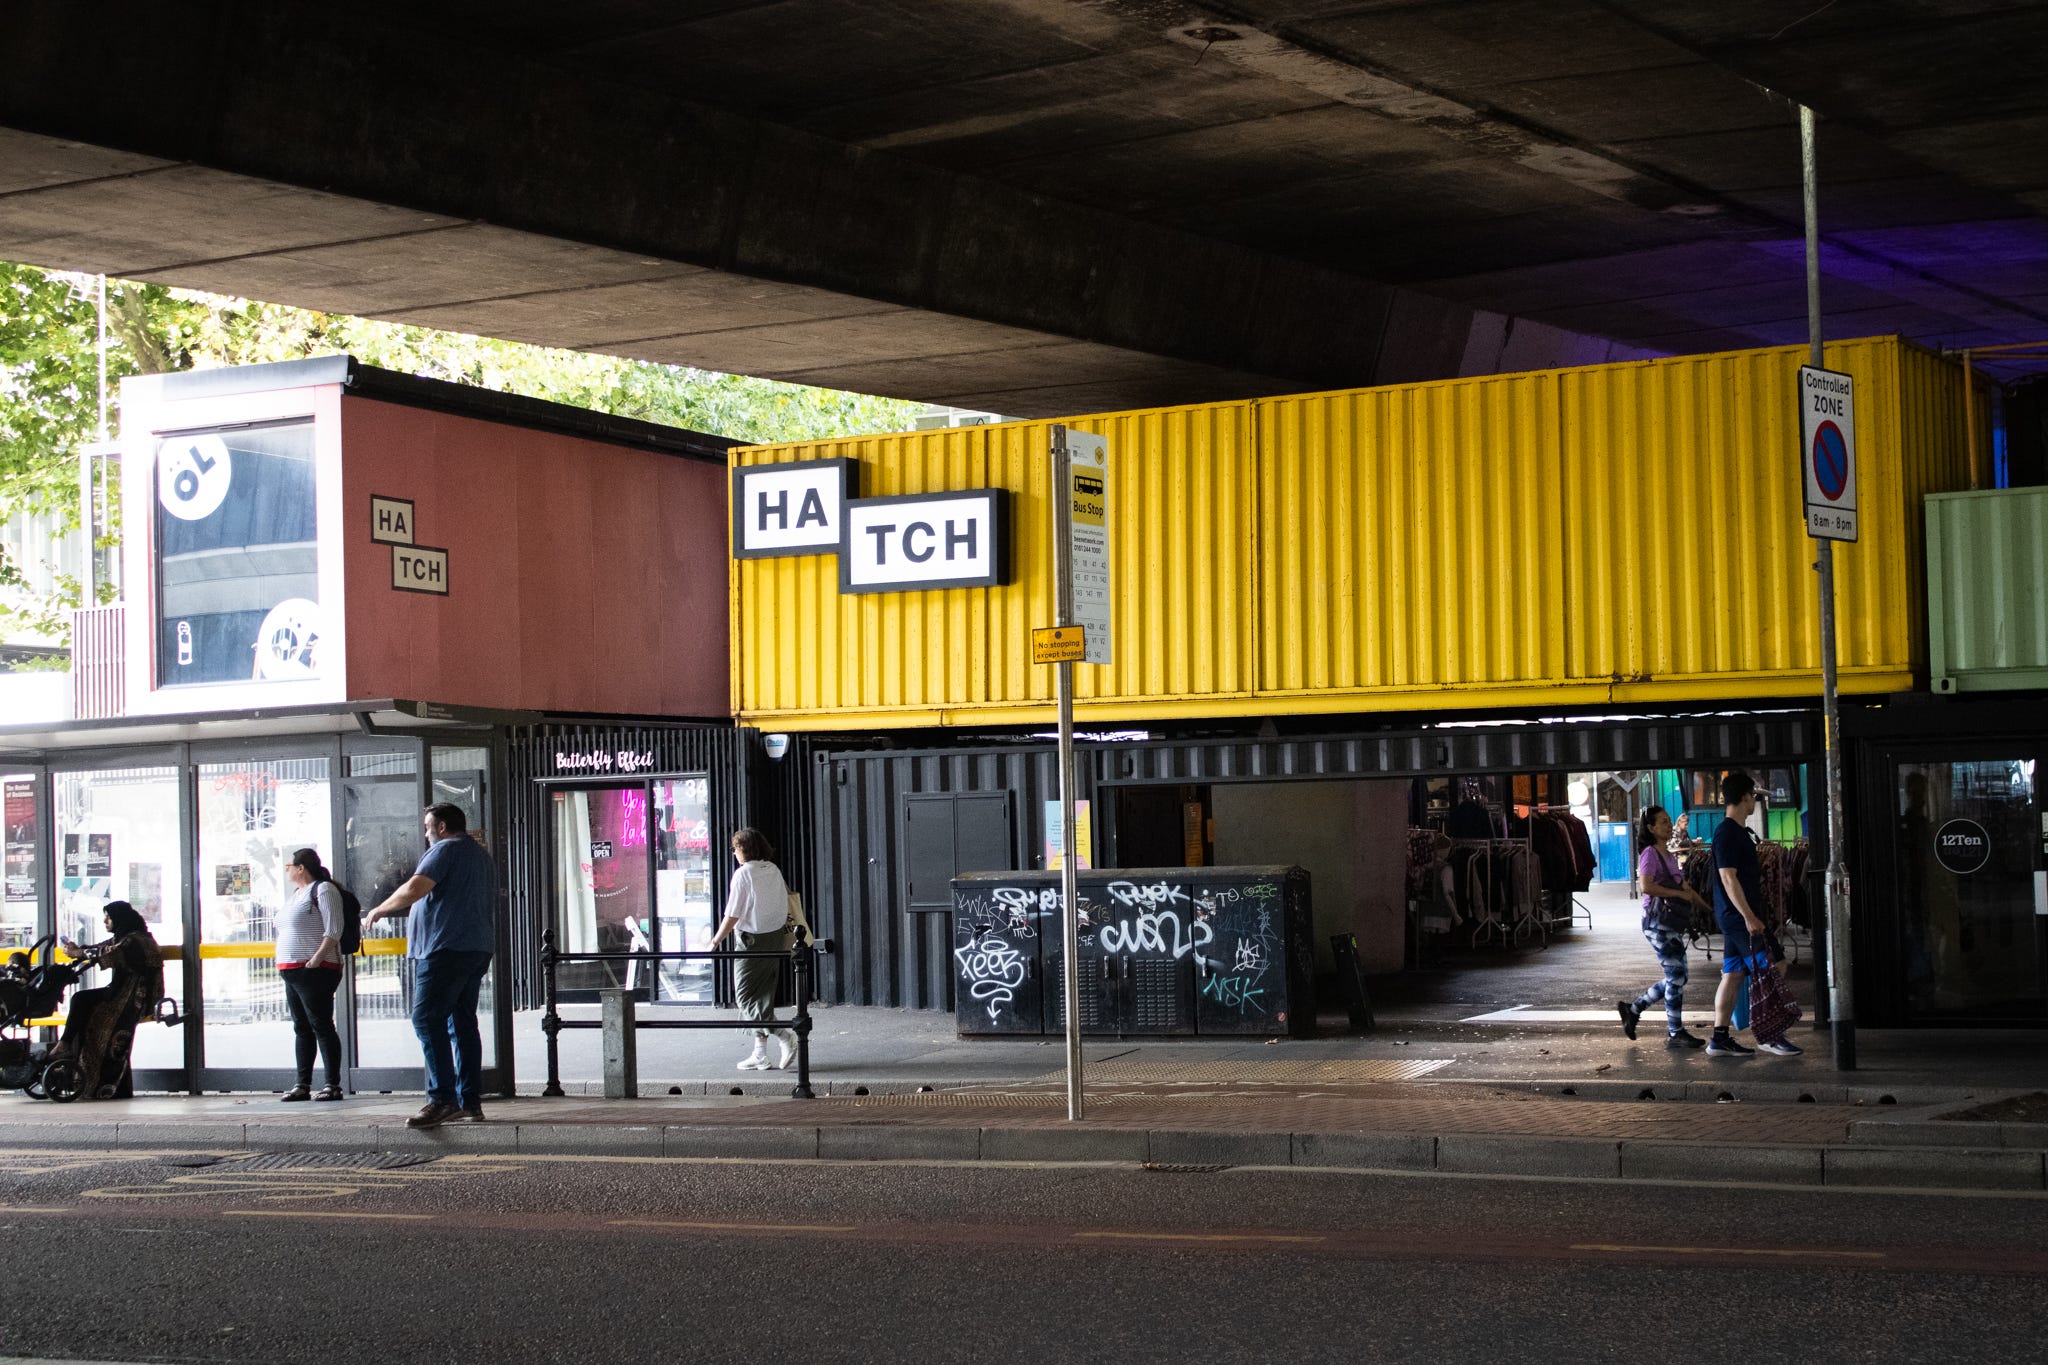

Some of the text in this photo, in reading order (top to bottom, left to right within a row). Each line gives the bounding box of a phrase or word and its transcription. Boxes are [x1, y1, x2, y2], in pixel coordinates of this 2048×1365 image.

[1806, 373, 1850, 396] Controlled
[1814, 394, 1843, 417] ZONE
[758, 488, 828, 531] HA
[1073, 500, 1104, 518] Bus Stop
[379, 509, 407, 534] HA
[866, 518, 977, 566] TCH
[399, 556, 441, 582] TCH
[1050, 640, 1080, 649] stopping
[555, 750, 655, 772] Butterfly Effect
[1941, 834, 1982, 846] 12Ten
[594, 849, 610, 858] OPEN
